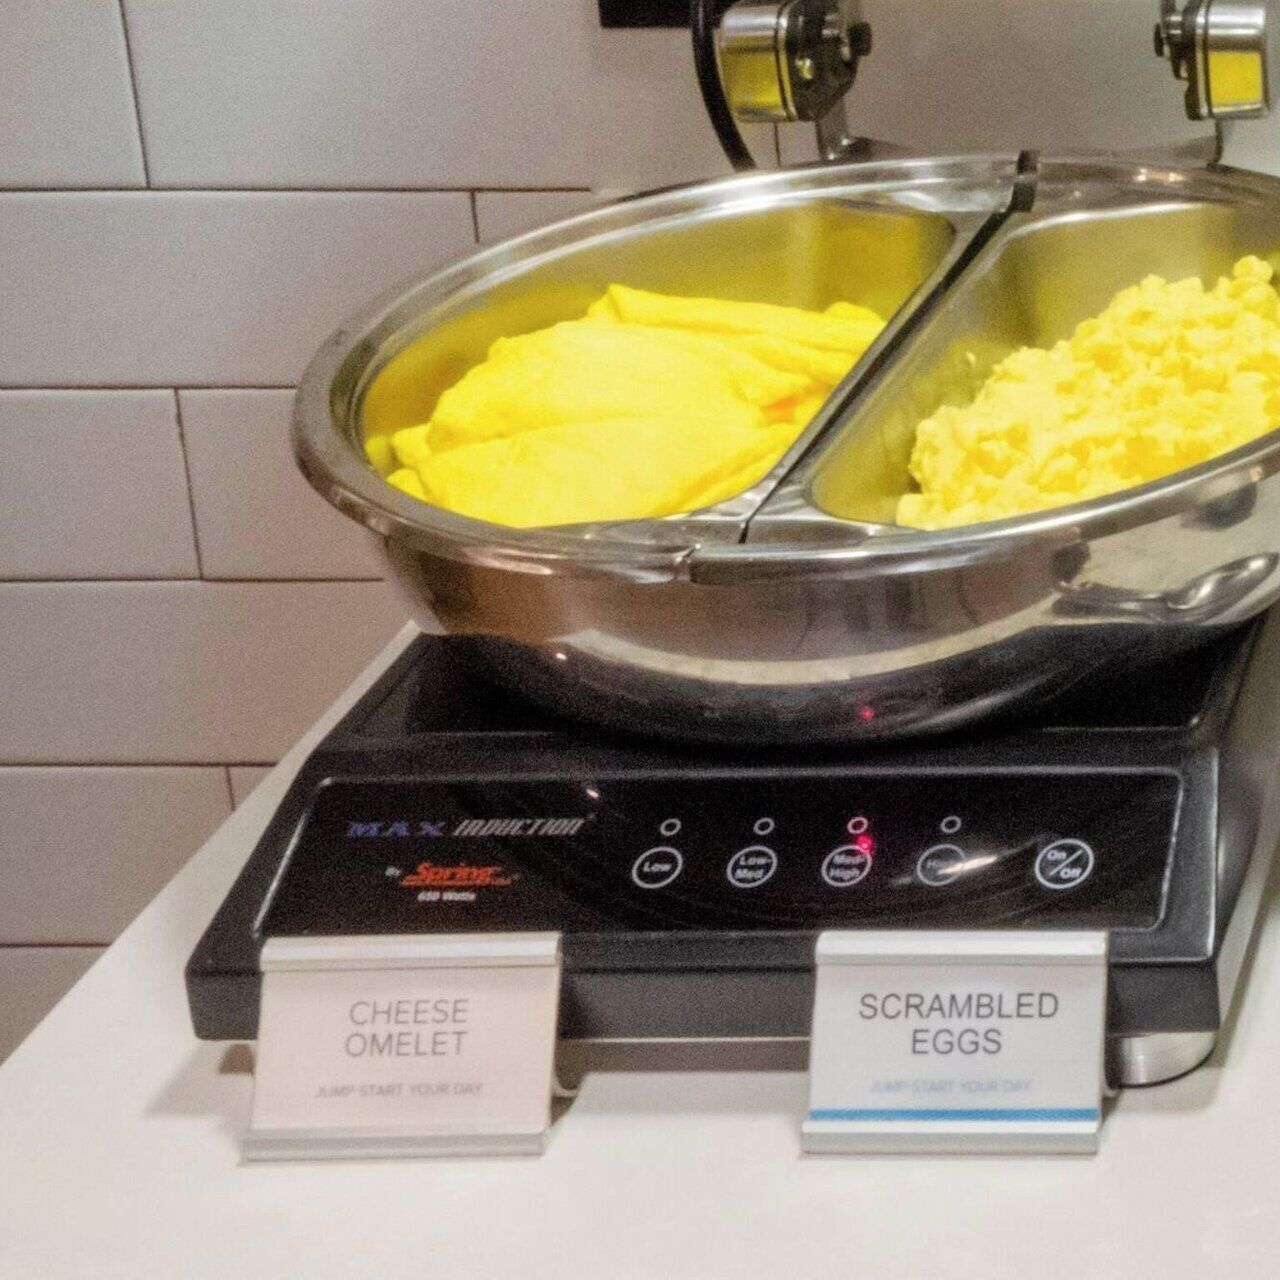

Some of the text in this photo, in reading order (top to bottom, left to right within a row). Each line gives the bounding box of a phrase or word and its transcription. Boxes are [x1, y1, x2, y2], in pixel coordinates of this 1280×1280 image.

[348, 822, 444, 836] MAX
[643, 862, 672, 872] Low
[349, 998, 469, 1025] CHEESE
[858, 992, 1059, 1020] SCRAMBLED
[345, 1031, 468, 1057] OMELET
[911, 1028, 1003, 1055] EGGS
[410, 1083, 450, 1096] YOUR
[453, 1082, 483, 1096] DAY
[960, 1079, 998, 1093] YOUR
[1002, 1078, 1033, 1093] DAY
